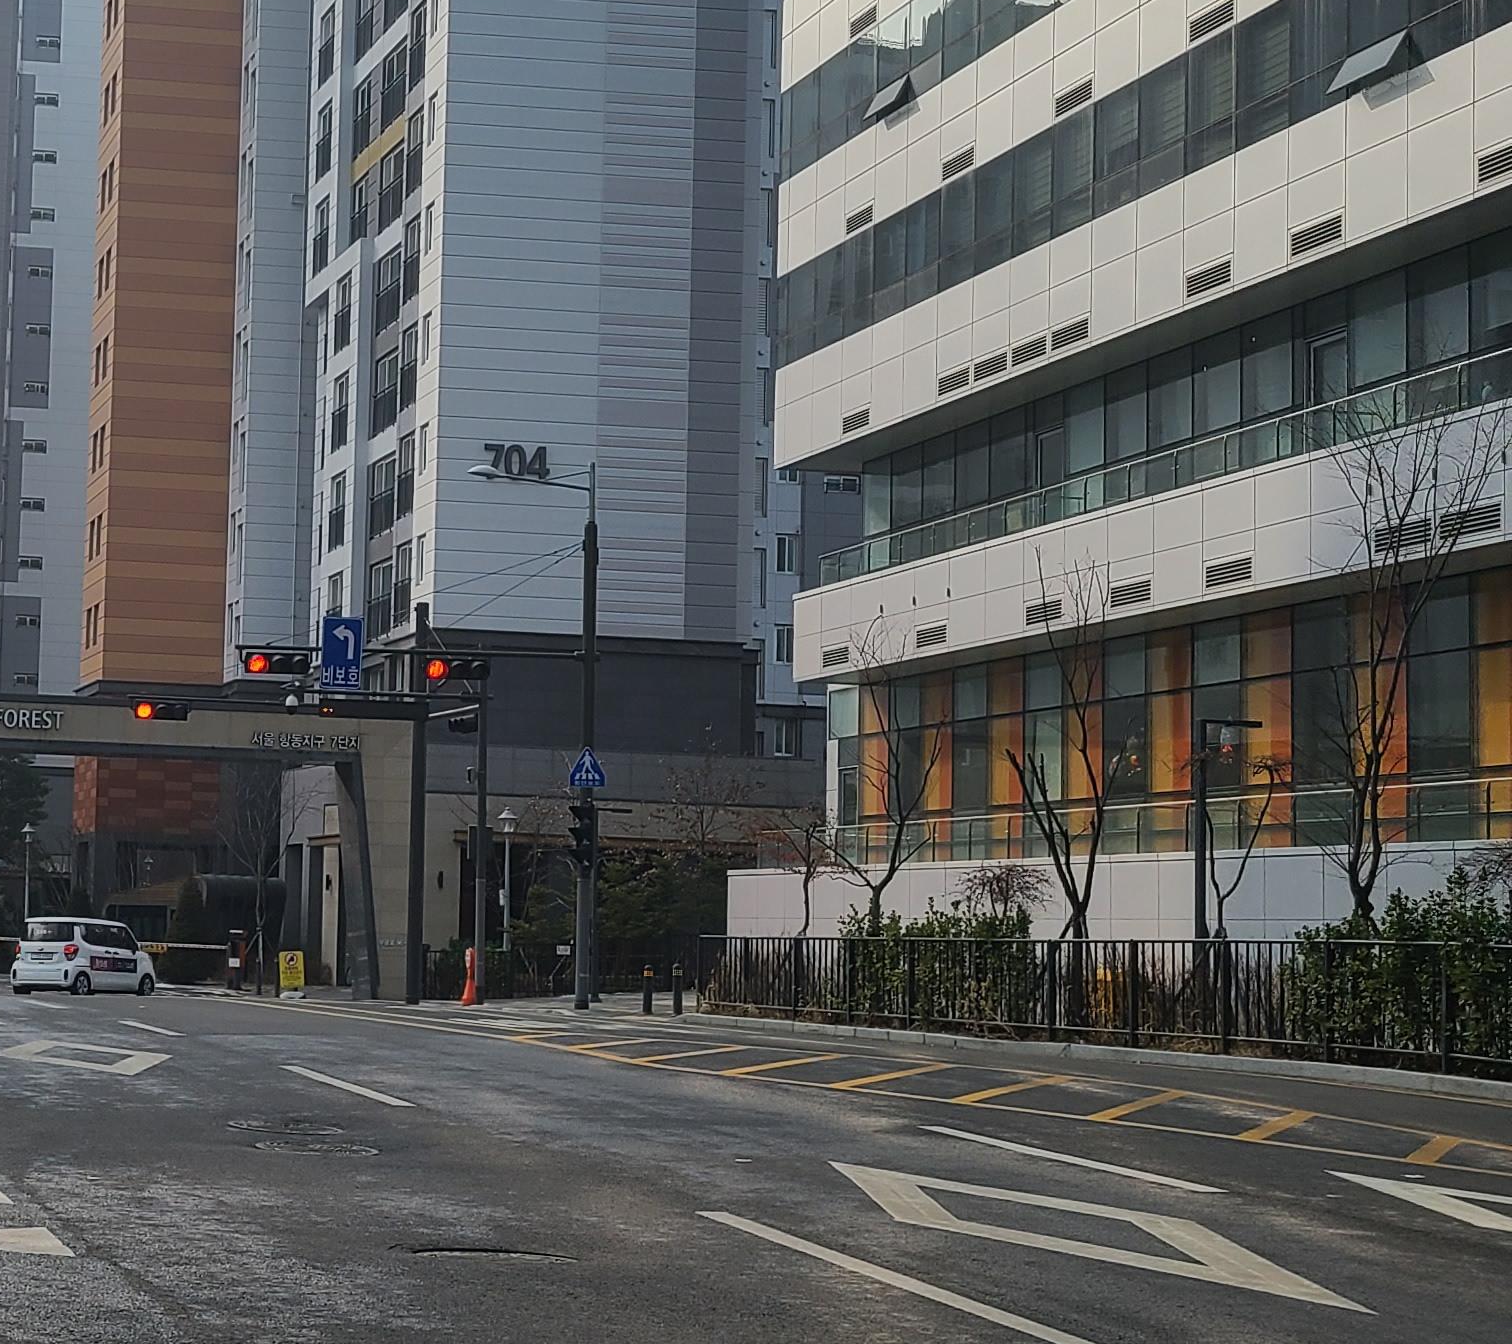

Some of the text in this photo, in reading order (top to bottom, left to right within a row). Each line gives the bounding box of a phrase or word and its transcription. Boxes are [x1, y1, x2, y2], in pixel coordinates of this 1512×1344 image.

[484, 443, 550, 479] 704
[322, 665, 359, 686] 비보호
[251, 732, 360, 750] 서울 항동지구 7단지
